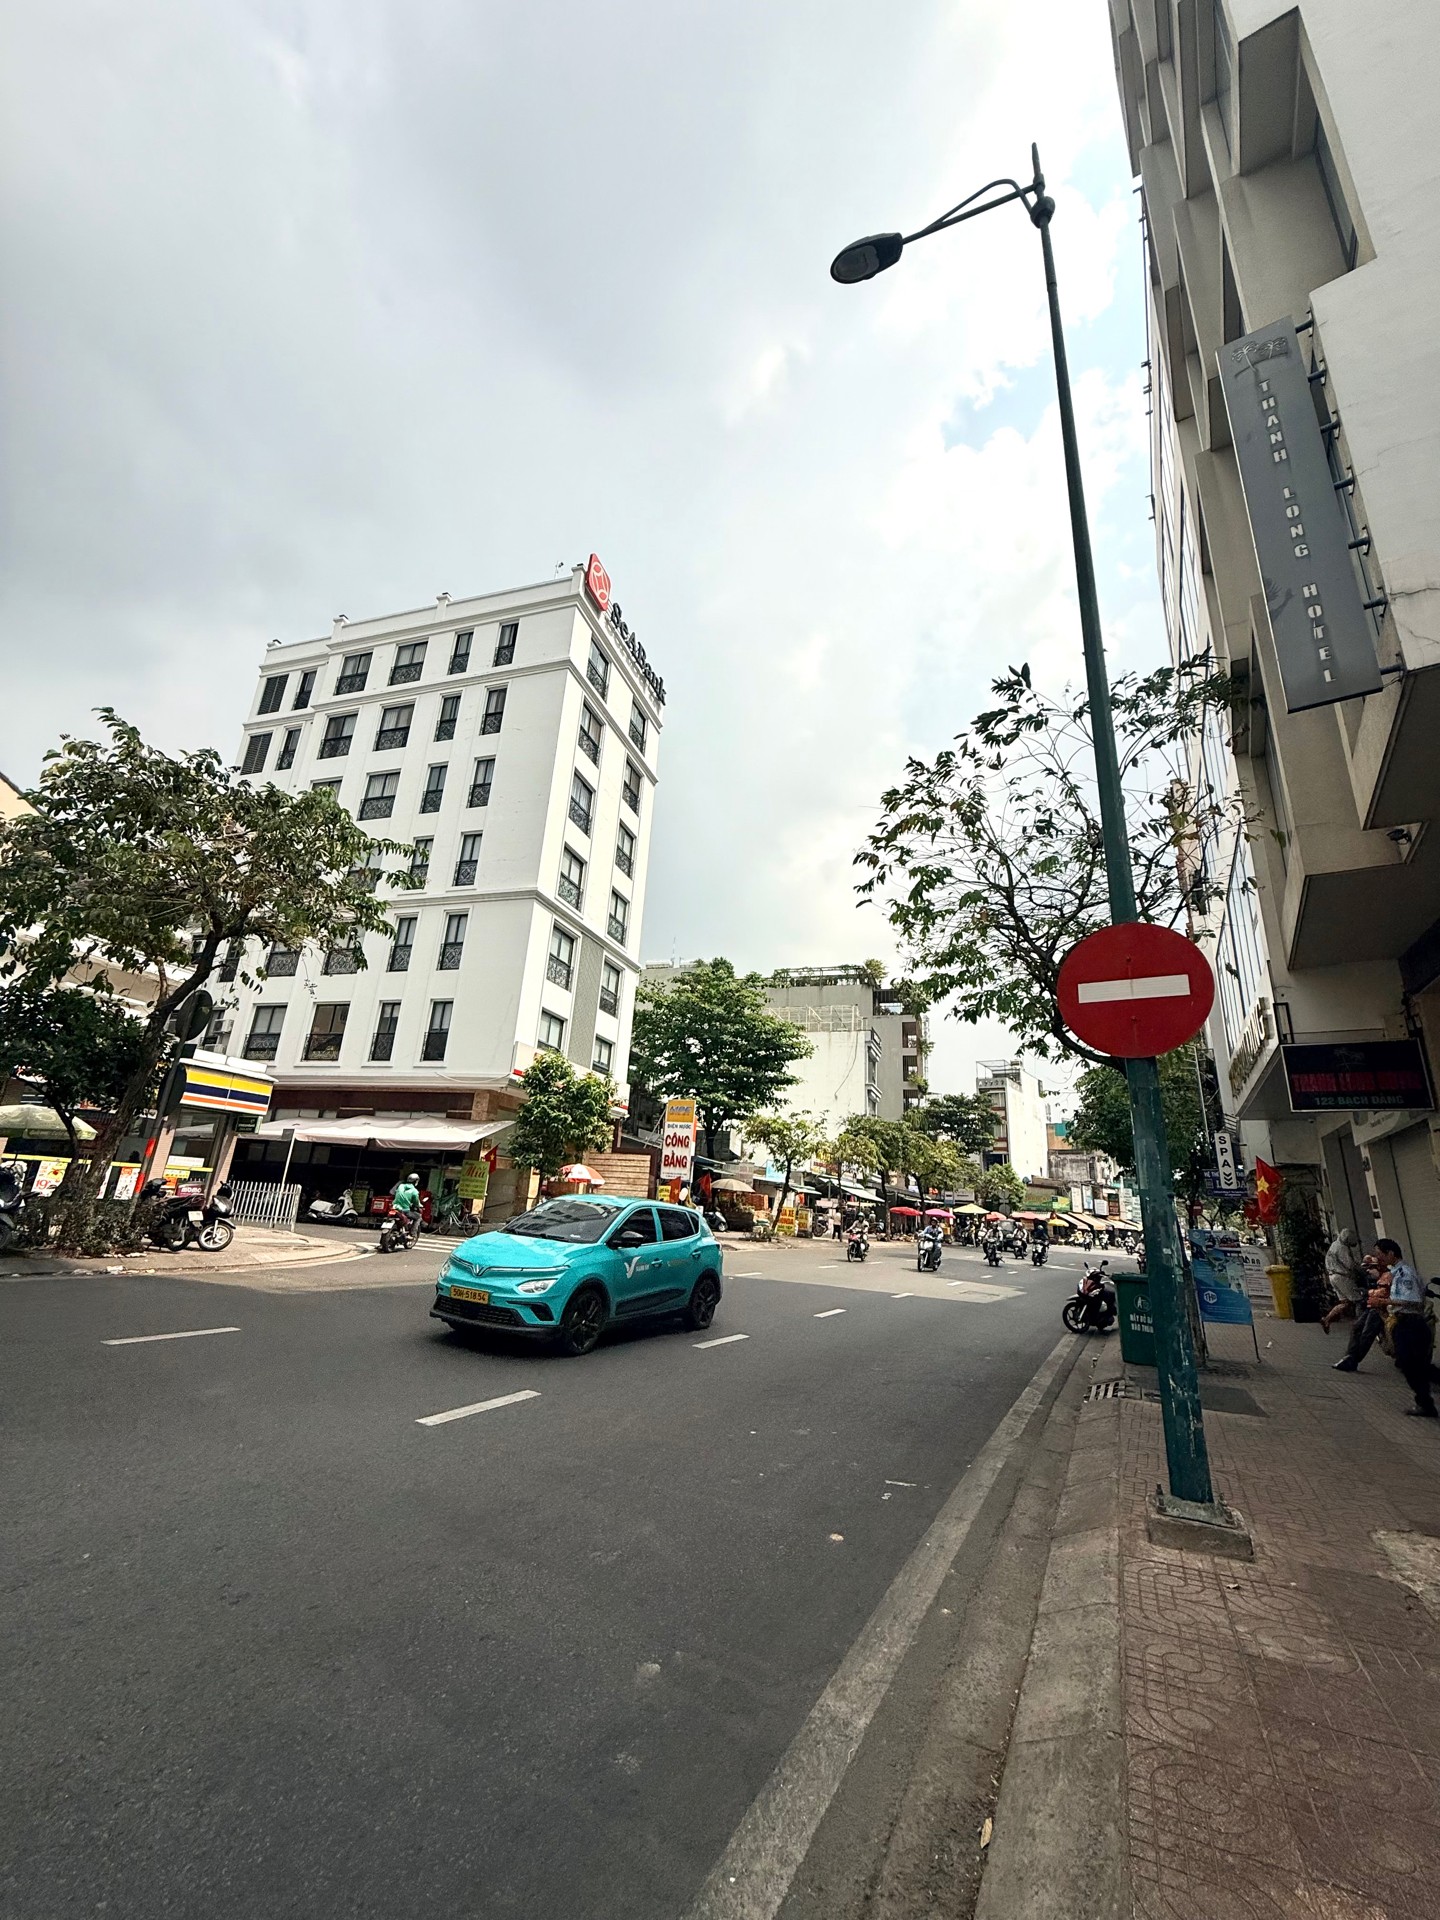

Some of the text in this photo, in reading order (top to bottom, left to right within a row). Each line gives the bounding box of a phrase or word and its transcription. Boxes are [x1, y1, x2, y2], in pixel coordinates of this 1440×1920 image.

[1258, 380, 1336, 683] THANH LONG HOTEL
[1314, 1097, 1335, 1106] 122
[665, 1132, 690, 1148] CÔNG
[1218, 1135, 1231, 1168] SPA
